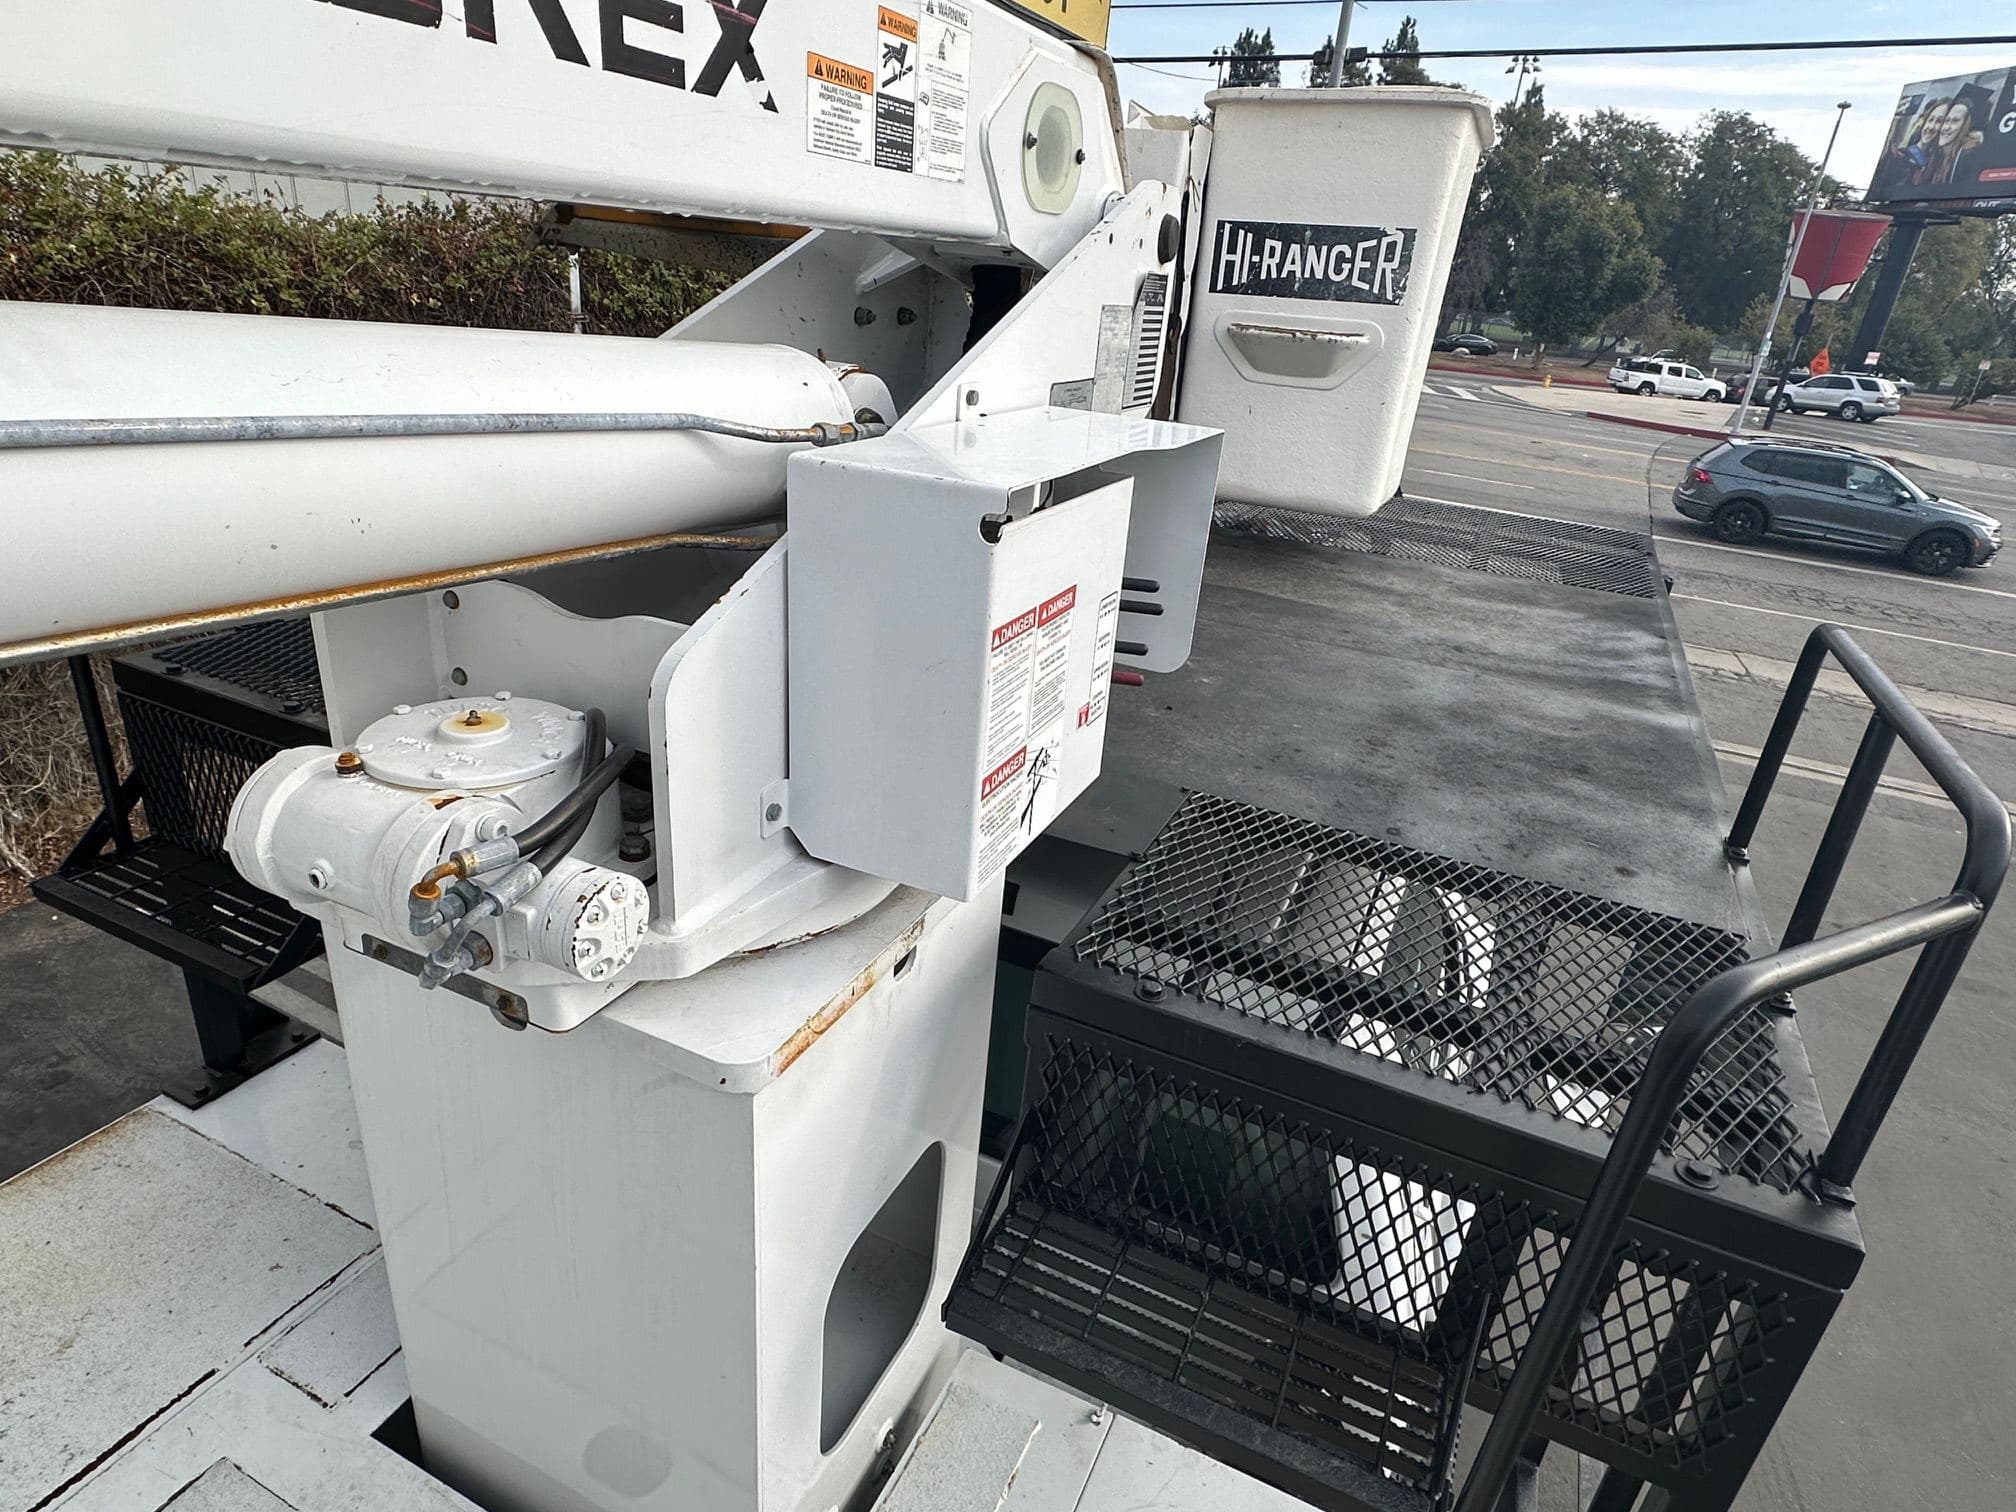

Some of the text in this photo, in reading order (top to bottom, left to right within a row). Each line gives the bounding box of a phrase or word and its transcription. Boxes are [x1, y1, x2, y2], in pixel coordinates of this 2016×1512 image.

[887, 16, 916, 38] WARNING
[938, 0, 968, 27] WARNING
[825, 63, 867, 90] WARNING
[1216, 221, 1404, 301] HI-RANGER
[1048, 592, 1074, 616] DANGER
[1001, 612, 1035, 641] DANGER
[991, 751, 1025, 789] DANGER
